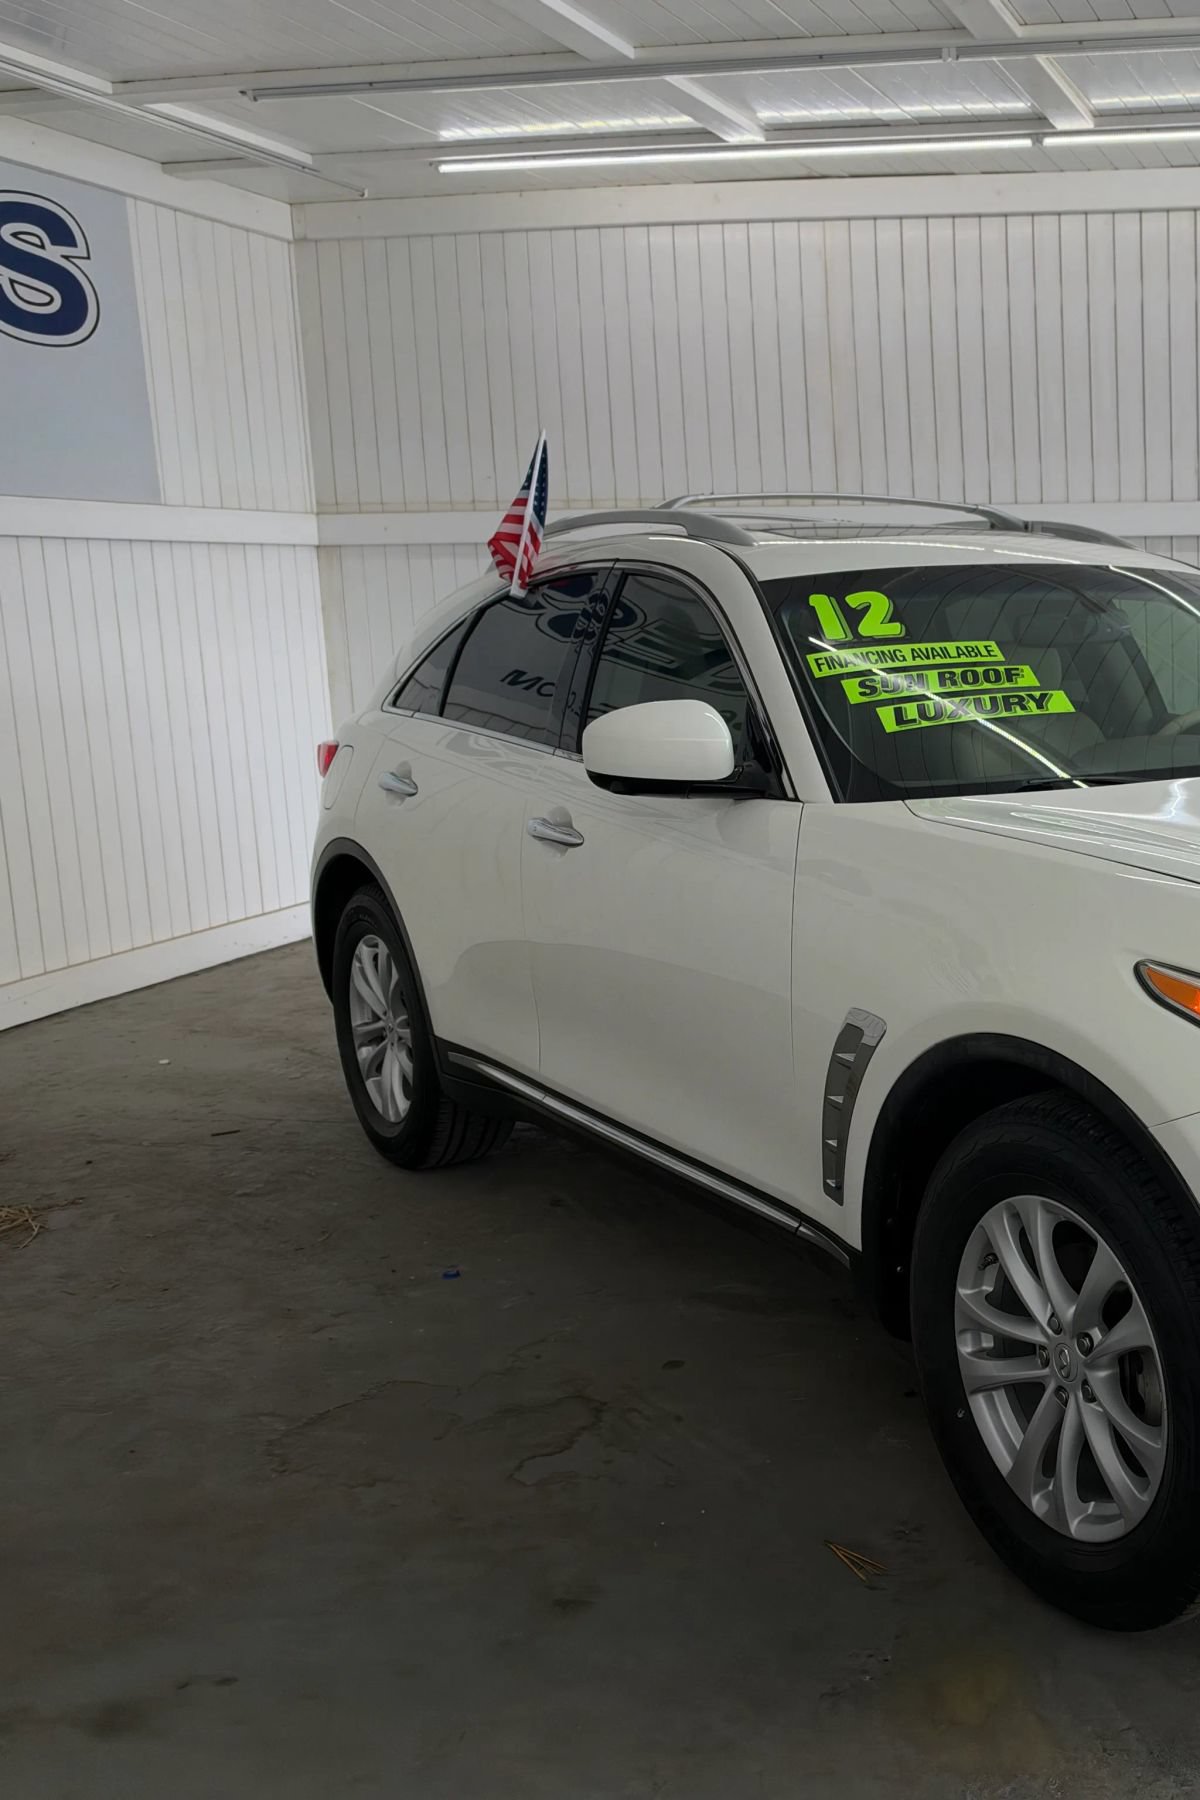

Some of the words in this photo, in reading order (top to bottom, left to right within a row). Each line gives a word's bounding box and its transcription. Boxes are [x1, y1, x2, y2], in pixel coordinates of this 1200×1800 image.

[808, 590, 906, 641] 12
[814, 648, 907, 673] FINANCING
[911, 645, 998, 662] AVAILABLE
[857, 672, 928, 698] SUN
[937, 667, 1025, 689] ROOF
[893, 692, 1054, 727] LUXURY
